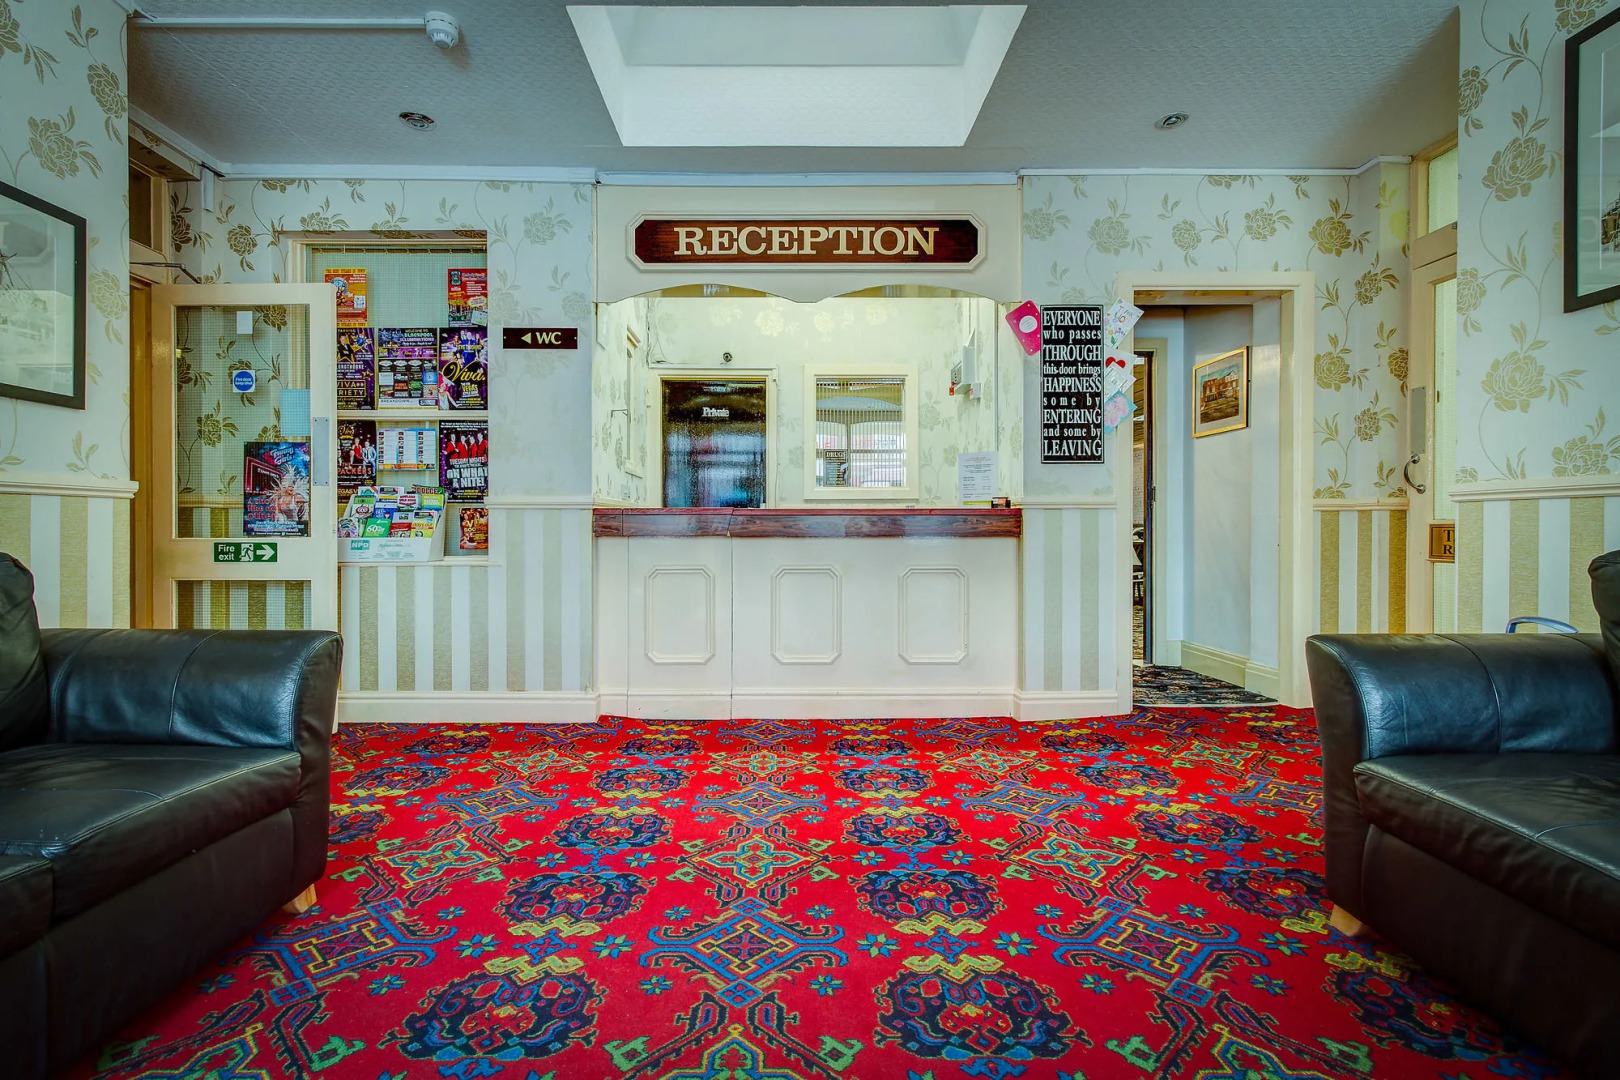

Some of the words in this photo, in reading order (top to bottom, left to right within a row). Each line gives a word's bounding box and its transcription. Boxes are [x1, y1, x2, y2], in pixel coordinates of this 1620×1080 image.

[673, 226, 940, 256] RECEPTION
[1043, 310, 1101, 326] EVERYONE
[536, 331, 562, 345] WC
[1043, 326, 1065, 340] who
[1068, 329, 1102, 344] passes
[1043, 344, 1102, 361] THROUGH
[1043, 363, 1058, 374] this
[1059, 363, 1077, 374] door
[1078, 363, 1101, 379] brings
[1043, 377, 1102, 393] HAPPINESS
[1043, 397, 1077, 406] some
[1086, 393, 1101, 409] by
[702, 406, 730, 417] Private
[1043, 408, 1102, 424] ENTERING
[1043, 424, 1060, 437] and
[1063, 428, 1087, 437] some
[1091, 424, 1102, 440] by
[1043, 439, 1102, 456] LEAVING
[218, 544, 235, 552] Fire
[218, 552, 235, 561] exit
